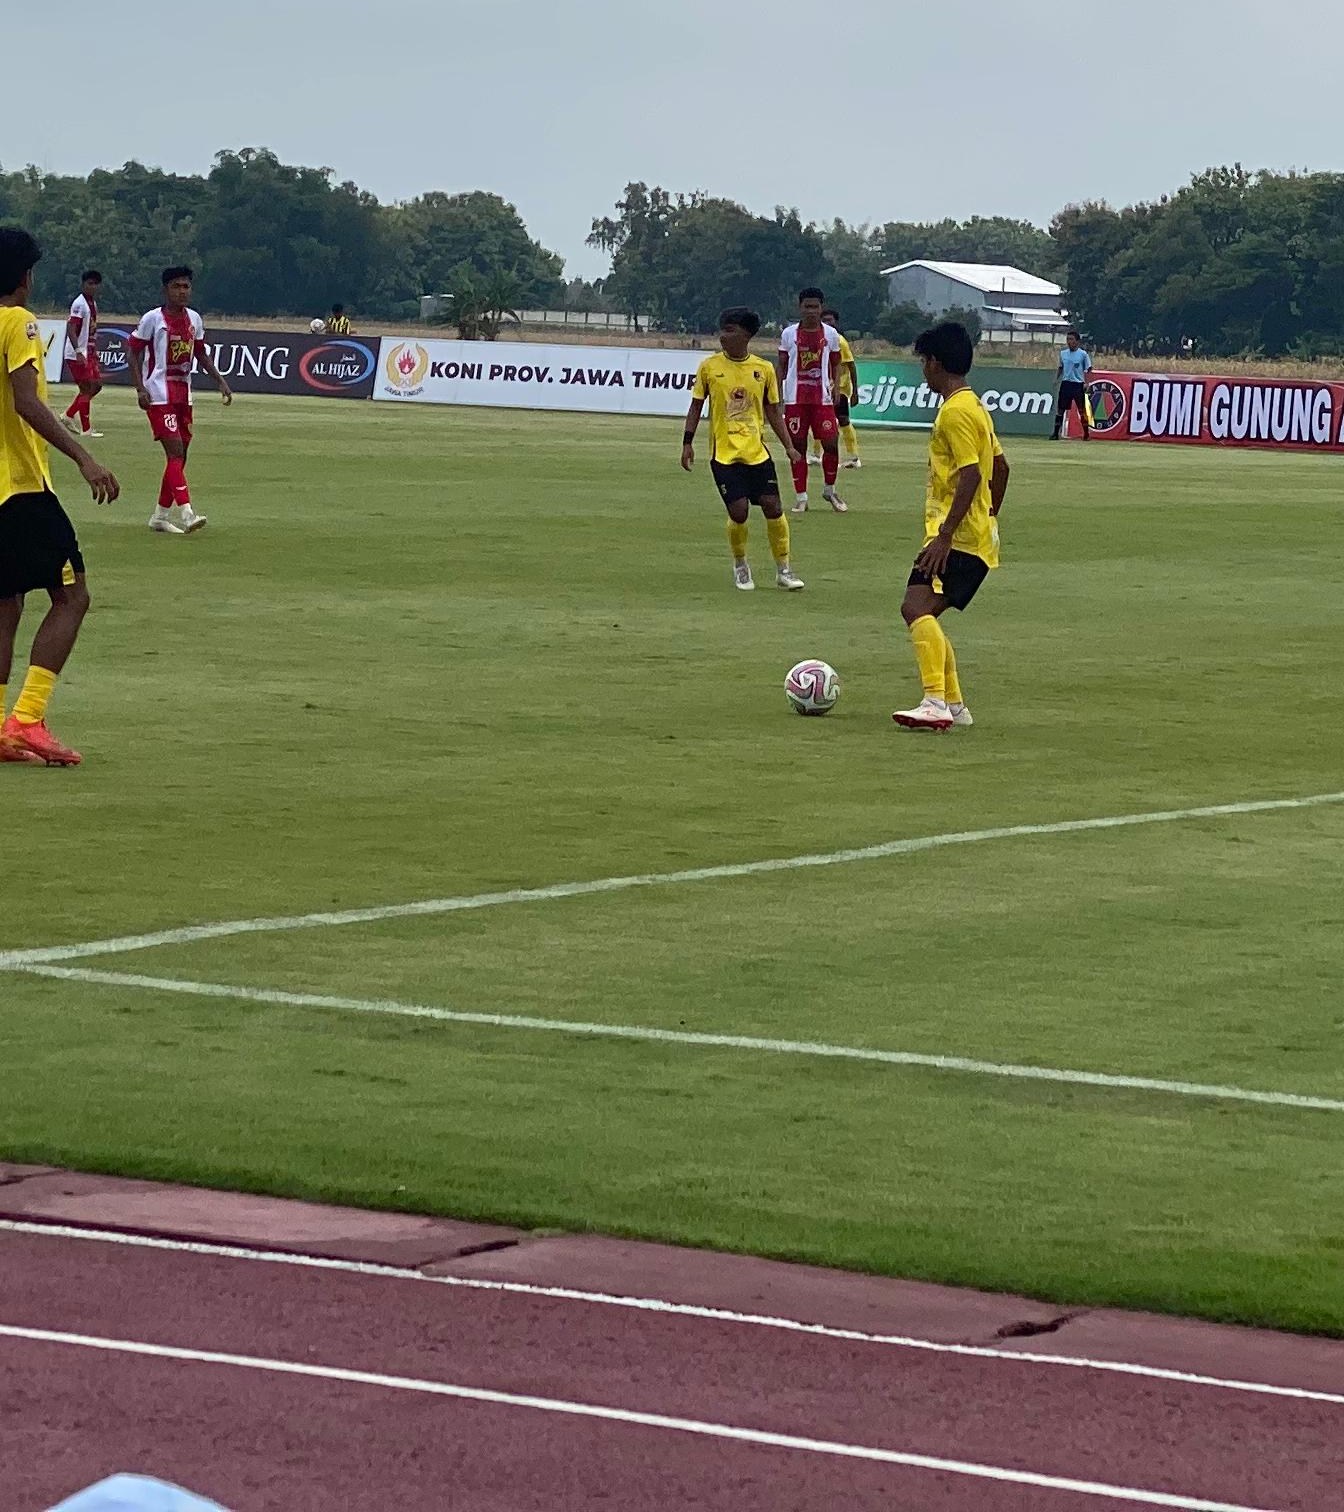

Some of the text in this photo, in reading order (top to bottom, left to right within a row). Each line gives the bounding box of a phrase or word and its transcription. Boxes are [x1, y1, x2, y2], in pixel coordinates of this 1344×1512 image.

[312, 362, 360, 379] AL HIJAZ
[430, 362, 481, 380] KONI
[489, 365, 553, 384] PROV.
[560, 368, 624, 388] JAWA
[1130, 382, 1204, 436] BUMI
[1210, 384, 1332, 443] GUNUNG
